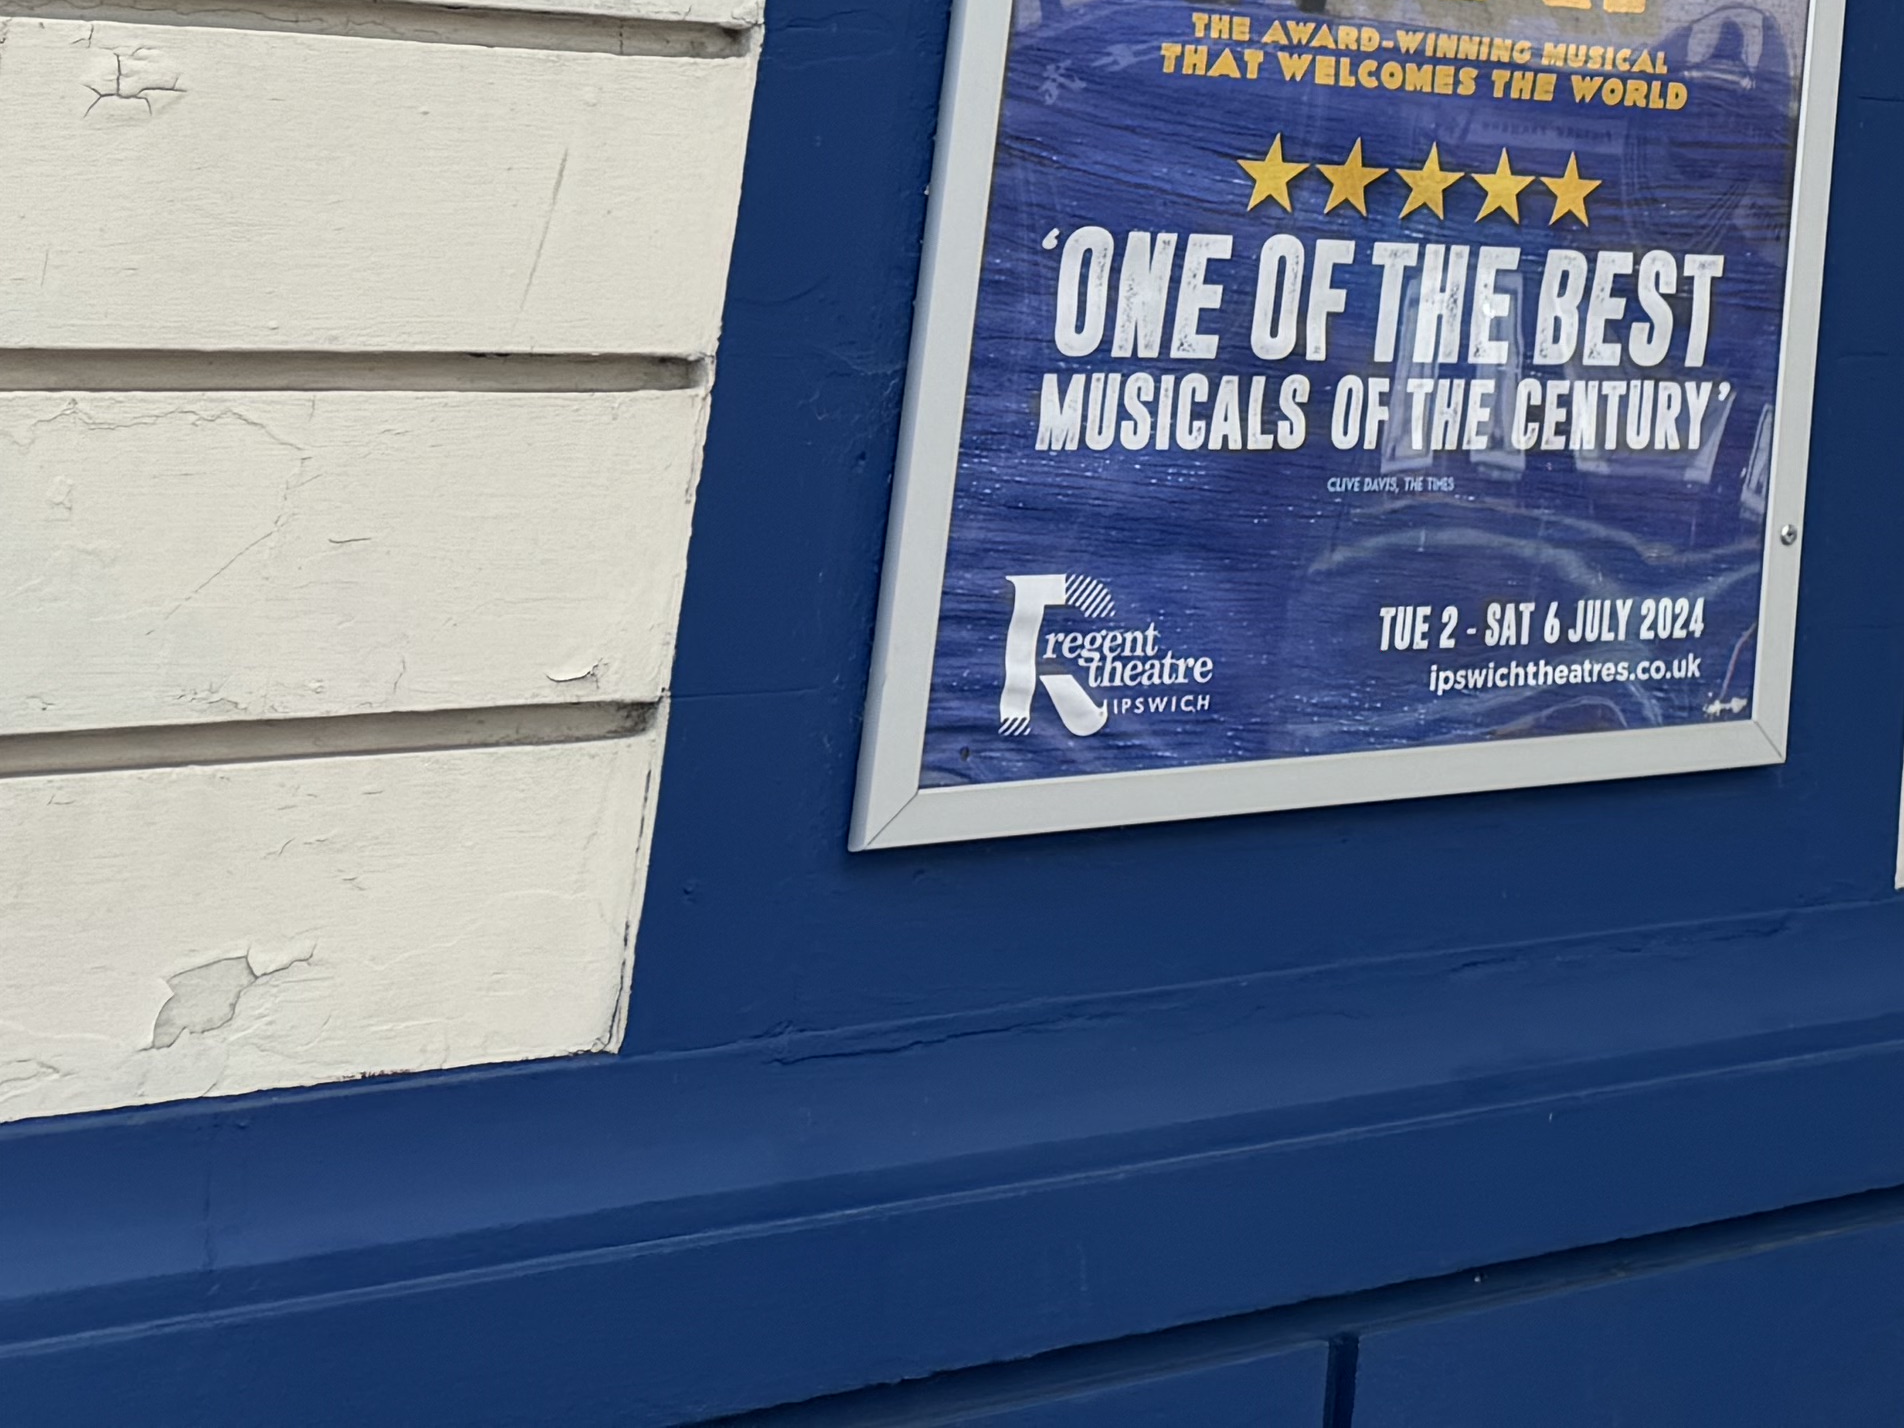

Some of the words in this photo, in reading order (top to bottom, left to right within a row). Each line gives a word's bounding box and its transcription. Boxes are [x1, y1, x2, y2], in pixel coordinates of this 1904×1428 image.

[1192, 12, 1250, 42] THE
[1261, 20, 1533, 64] AWARD-WINNING
[1541, 42, 1668, 74] MUSICAL
[1160, 43, 1264, 79] THAT
[1277, 50, 1476, 96] WELCOMES
[1491, 69, 1557, 101] THE
[1570, 76, 1688, 110] WORLD
[1250, 234, 1355, 362] OF
[1372, 241, 1521, 365] THE
[1532, 249, 1726, 368] BEST
[1034, 373, 1309, 451] MUSICALS
[1330, 377, 1391, 451] OF
[1406, 378, 1491, 451] THE
[1327, 476, 1361, 492] CLIVE
[1363, 476, 1399, 494] DAVIS,
[1403, 476, 1424, 492] THE
[1426, 476, 1455, 492] TIMES
[1043, 621, 1161, 666] regent
[1379, 605, 1432, 651] TUE
[1439, 605, 1459, 649] 2
[1466, 627, 1477, 635] -
[1484, 601, 1536, 647] SAT
[1544, 601, 1560, 644] 6
[1567, 597, 1634, 643] JULY
[1640, 597, 1705, 640] 2024
[1088, 650, 1213, 688] theatre
[1429, 653, 1702, 695] ipswichtheatres.co.uk
[1113, 694, 1211, 715] IPSWICH
